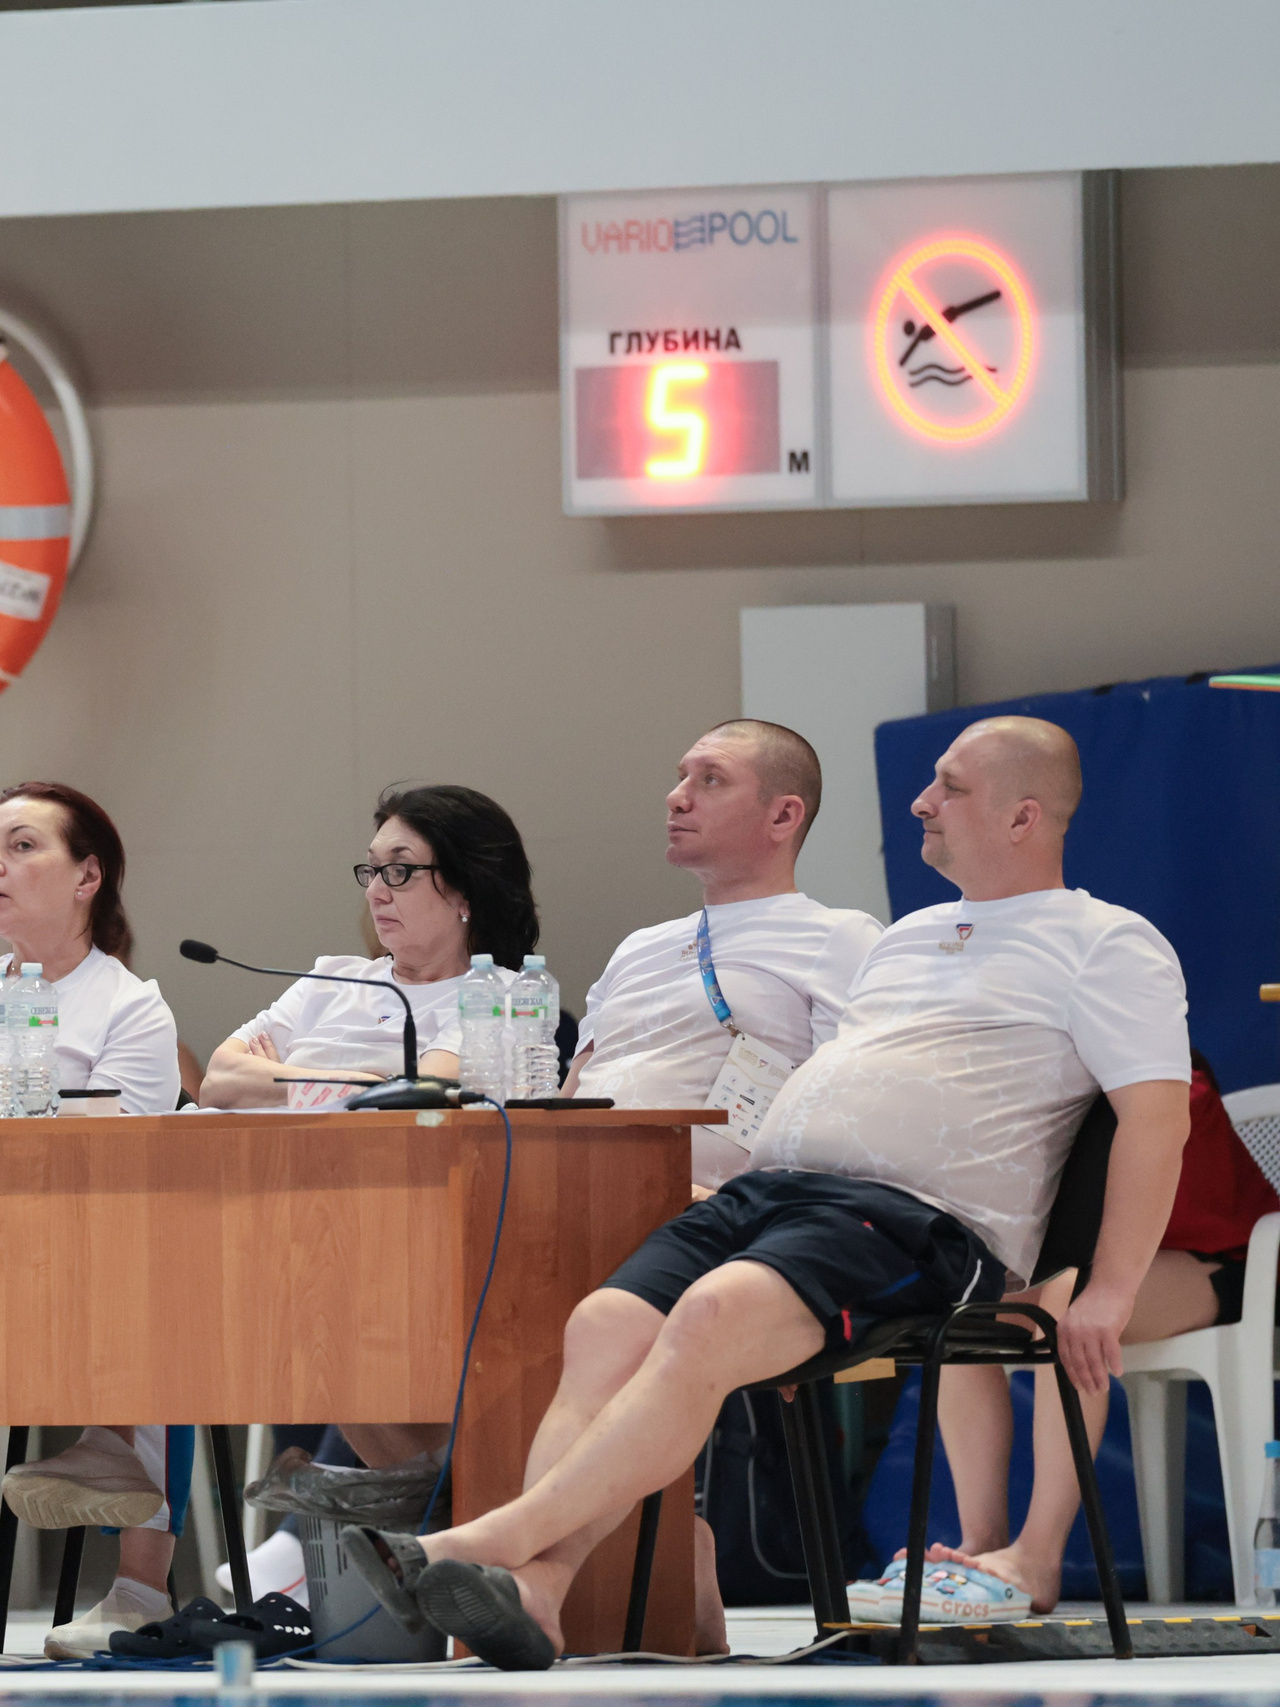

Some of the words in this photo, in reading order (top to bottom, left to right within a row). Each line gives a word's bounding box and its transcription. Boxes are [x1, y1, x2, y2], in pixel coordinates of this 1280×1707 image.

[581, 218, 674, 255] VARIO
[708, 209, 799, 245] POOL
[609, 327, 742, 355] ГЛУБИНА
[645, 364, 708, 478] 5
[788, 451, 810, 474] М
[941, 1600, 989, 1618] crocs
